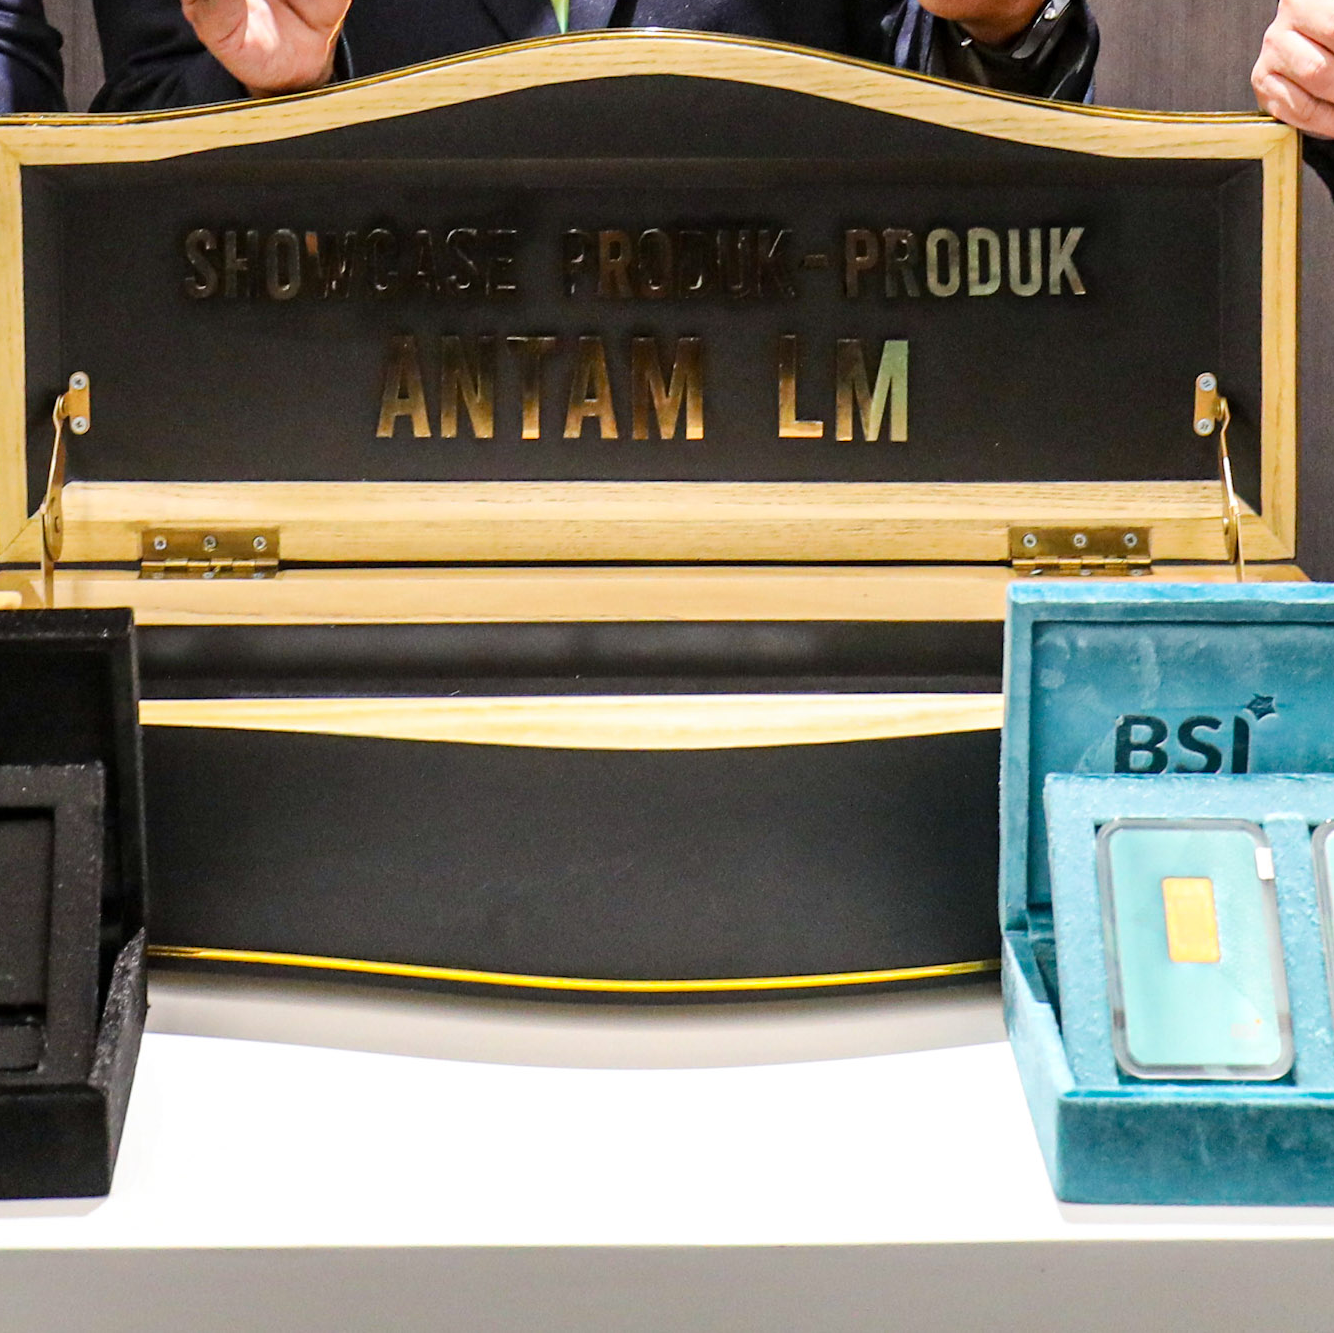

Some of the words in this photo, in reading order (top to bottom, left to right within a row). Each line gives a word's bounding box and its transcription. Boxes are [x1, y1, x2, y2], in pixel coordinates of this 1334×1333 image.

[184, 228, 518, 300] SHOWCASE
[375, 335, 705, 441] ANTAM
[778, 334, 909, 442] LM
[1114, 714, 1251, 774] BSI
